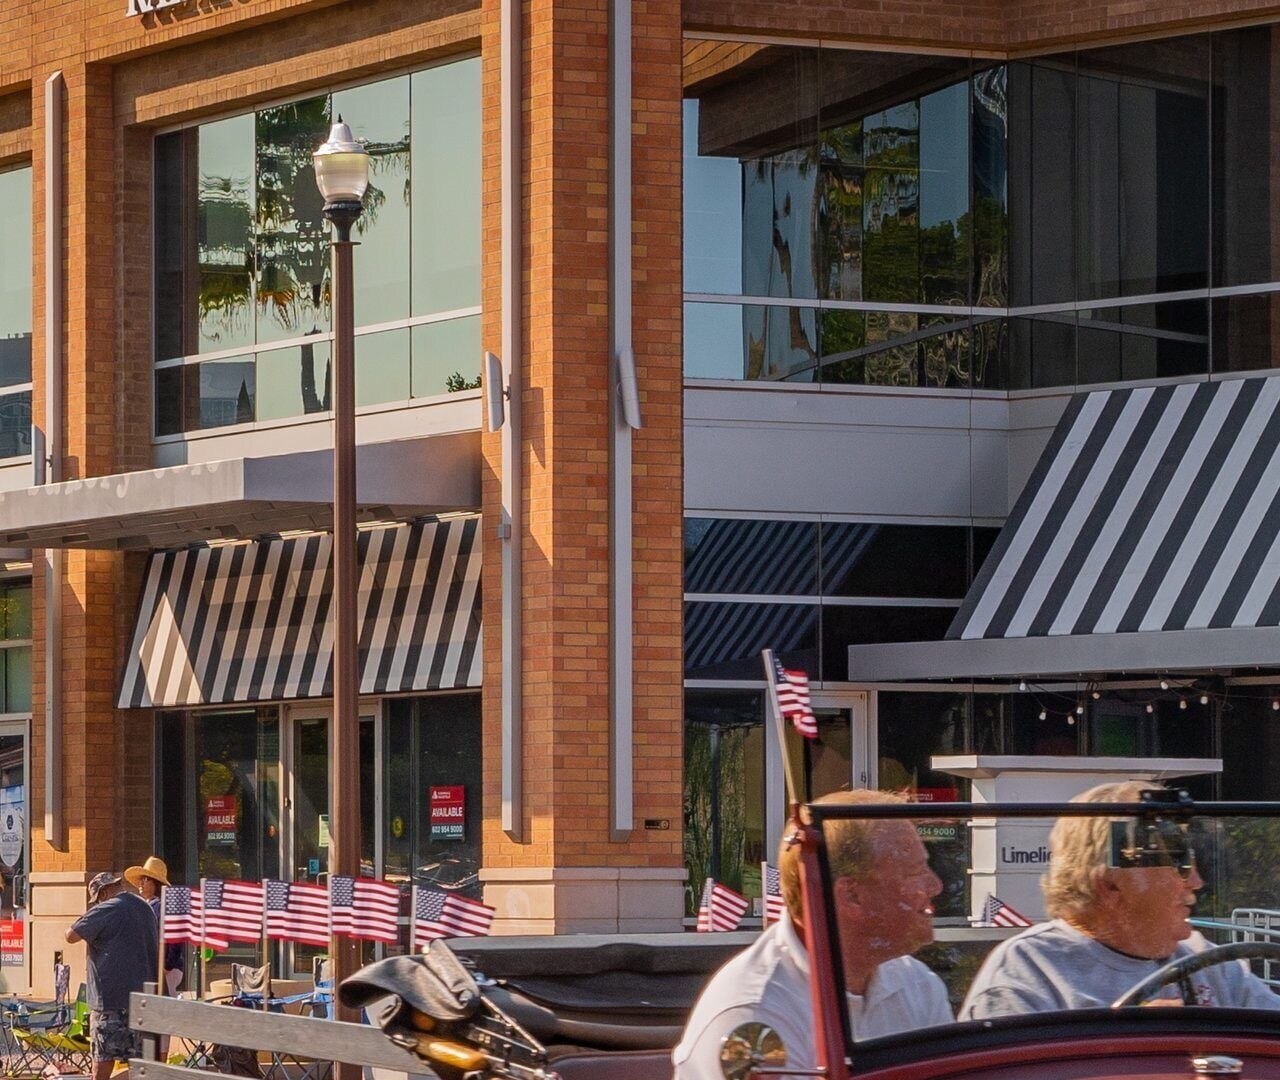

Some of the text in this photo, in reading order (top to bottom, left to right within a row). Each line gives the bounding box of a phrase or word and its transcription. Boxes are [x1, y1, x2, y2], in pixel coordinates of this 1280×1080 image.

[431, 807, 463, 817] AVAILABLE
[208, 815, 236, 825] AVAILABLE
[431, 825, 440, 833] 602
[441, 825, 450, 833] 954
[917, 827, 956, 836] 954 9000
[0, 938, 24, 948] VAILABLE
